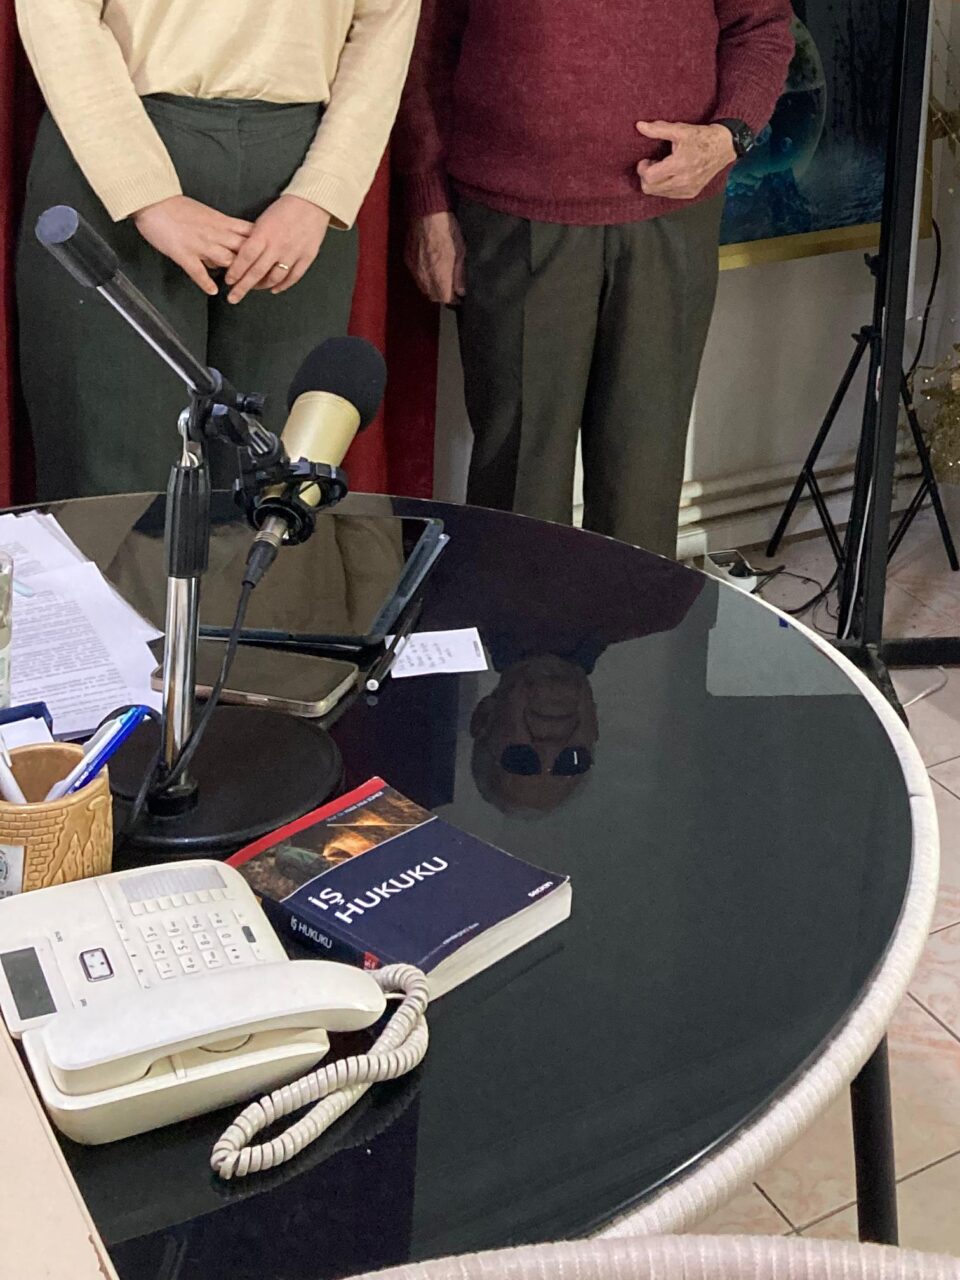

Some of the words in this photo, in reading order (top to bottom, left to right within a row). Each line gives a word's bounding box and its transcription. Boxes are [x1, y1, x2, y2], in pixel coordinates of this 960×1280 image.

[308, 887, 345, 911] İŞ
[334, 856, 449, 924] HUKUKU
[298, 922, 333, 949] HUKUKU
